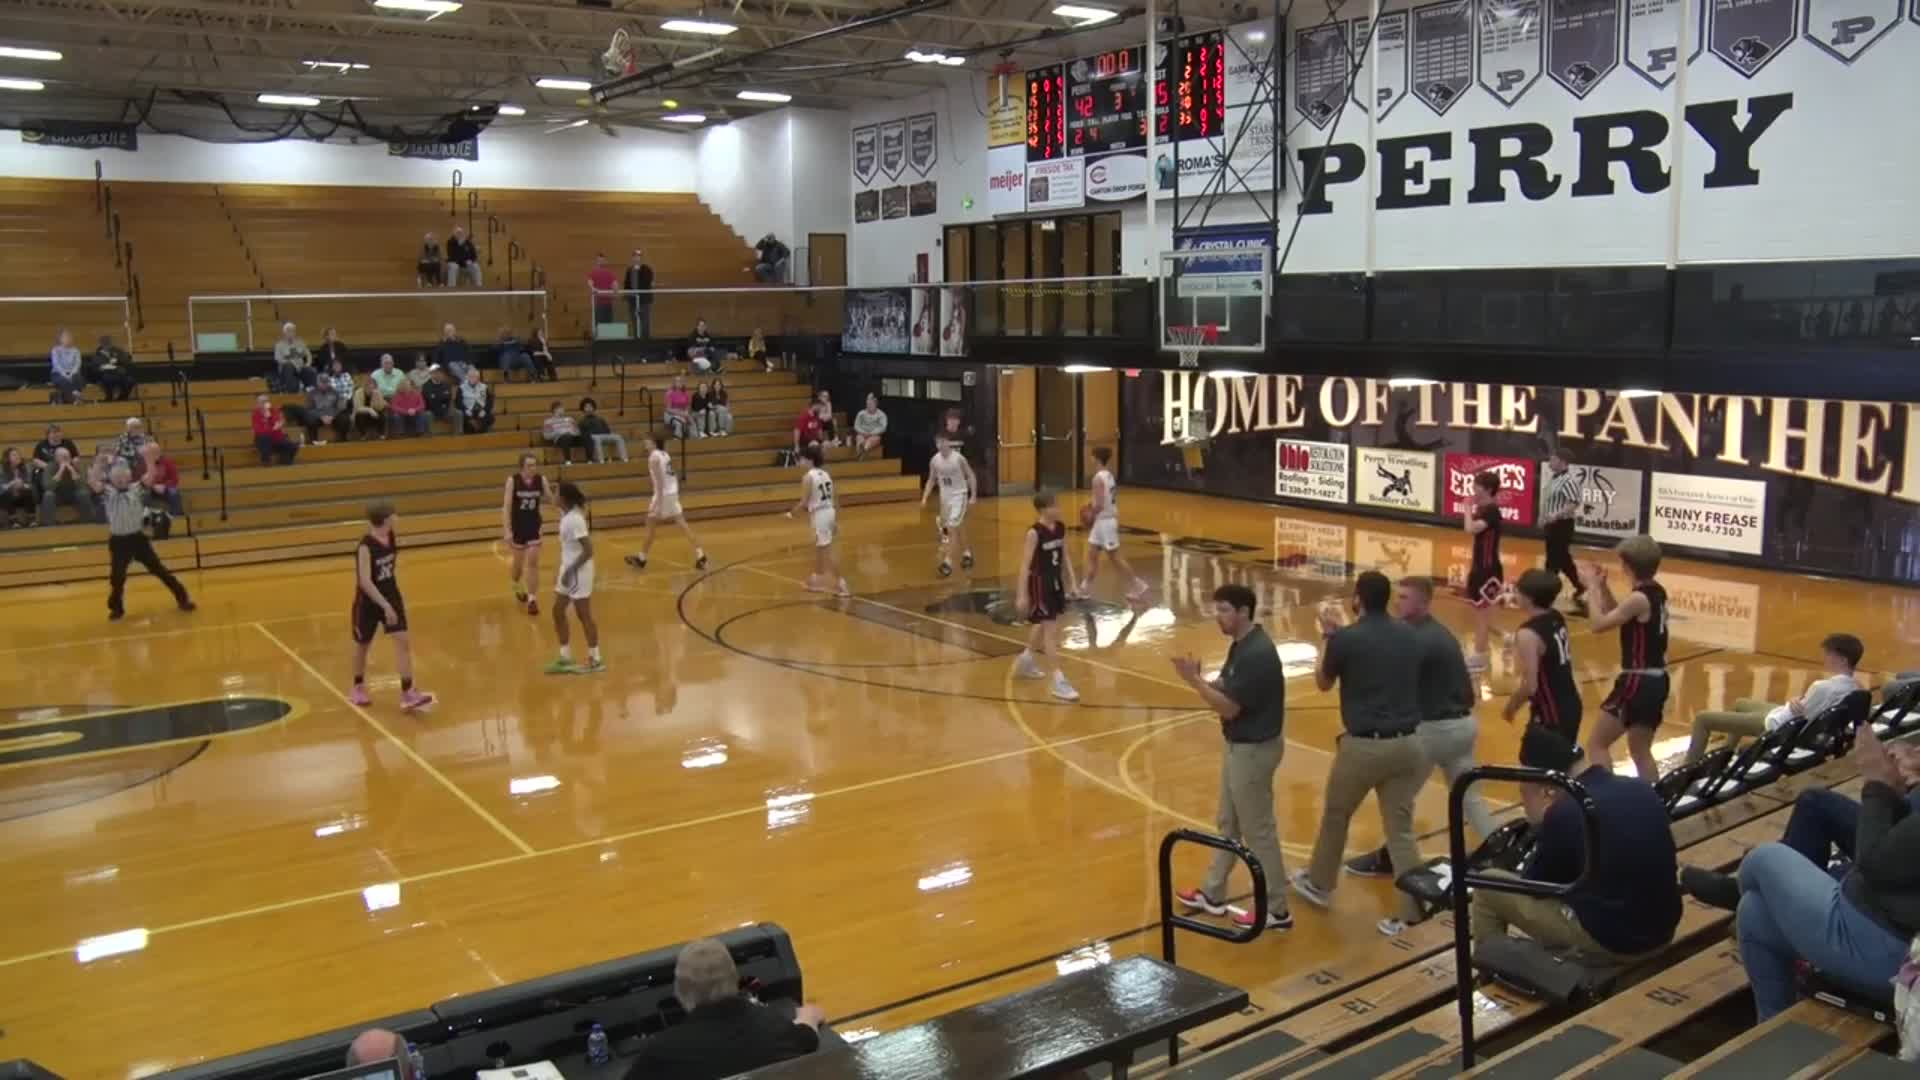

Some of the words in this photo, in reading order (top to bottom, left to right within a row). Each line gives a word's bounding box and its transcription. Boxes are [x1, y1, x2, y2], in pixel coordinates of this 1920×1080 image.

[1831, 16, 1875, 45] P
[1648, 47, 1677, 72] P
[1497, 69, 1525, 91] P
[1074, 95, 1095, 118] 42
[1178, 155, 1224, 170] ROMA'S
[1297, 93, 1793, 216] PERRY
[990, 169, 1024, 192] meijer
[1160, 369, 1305, 445] HOME
[1319, 376, 1393, 428] OF
[1408, 379, 1540, 433] THE
[1655, 504, 1702, 521] KENNY
[1704, 510, 1759, 528] FREASE
